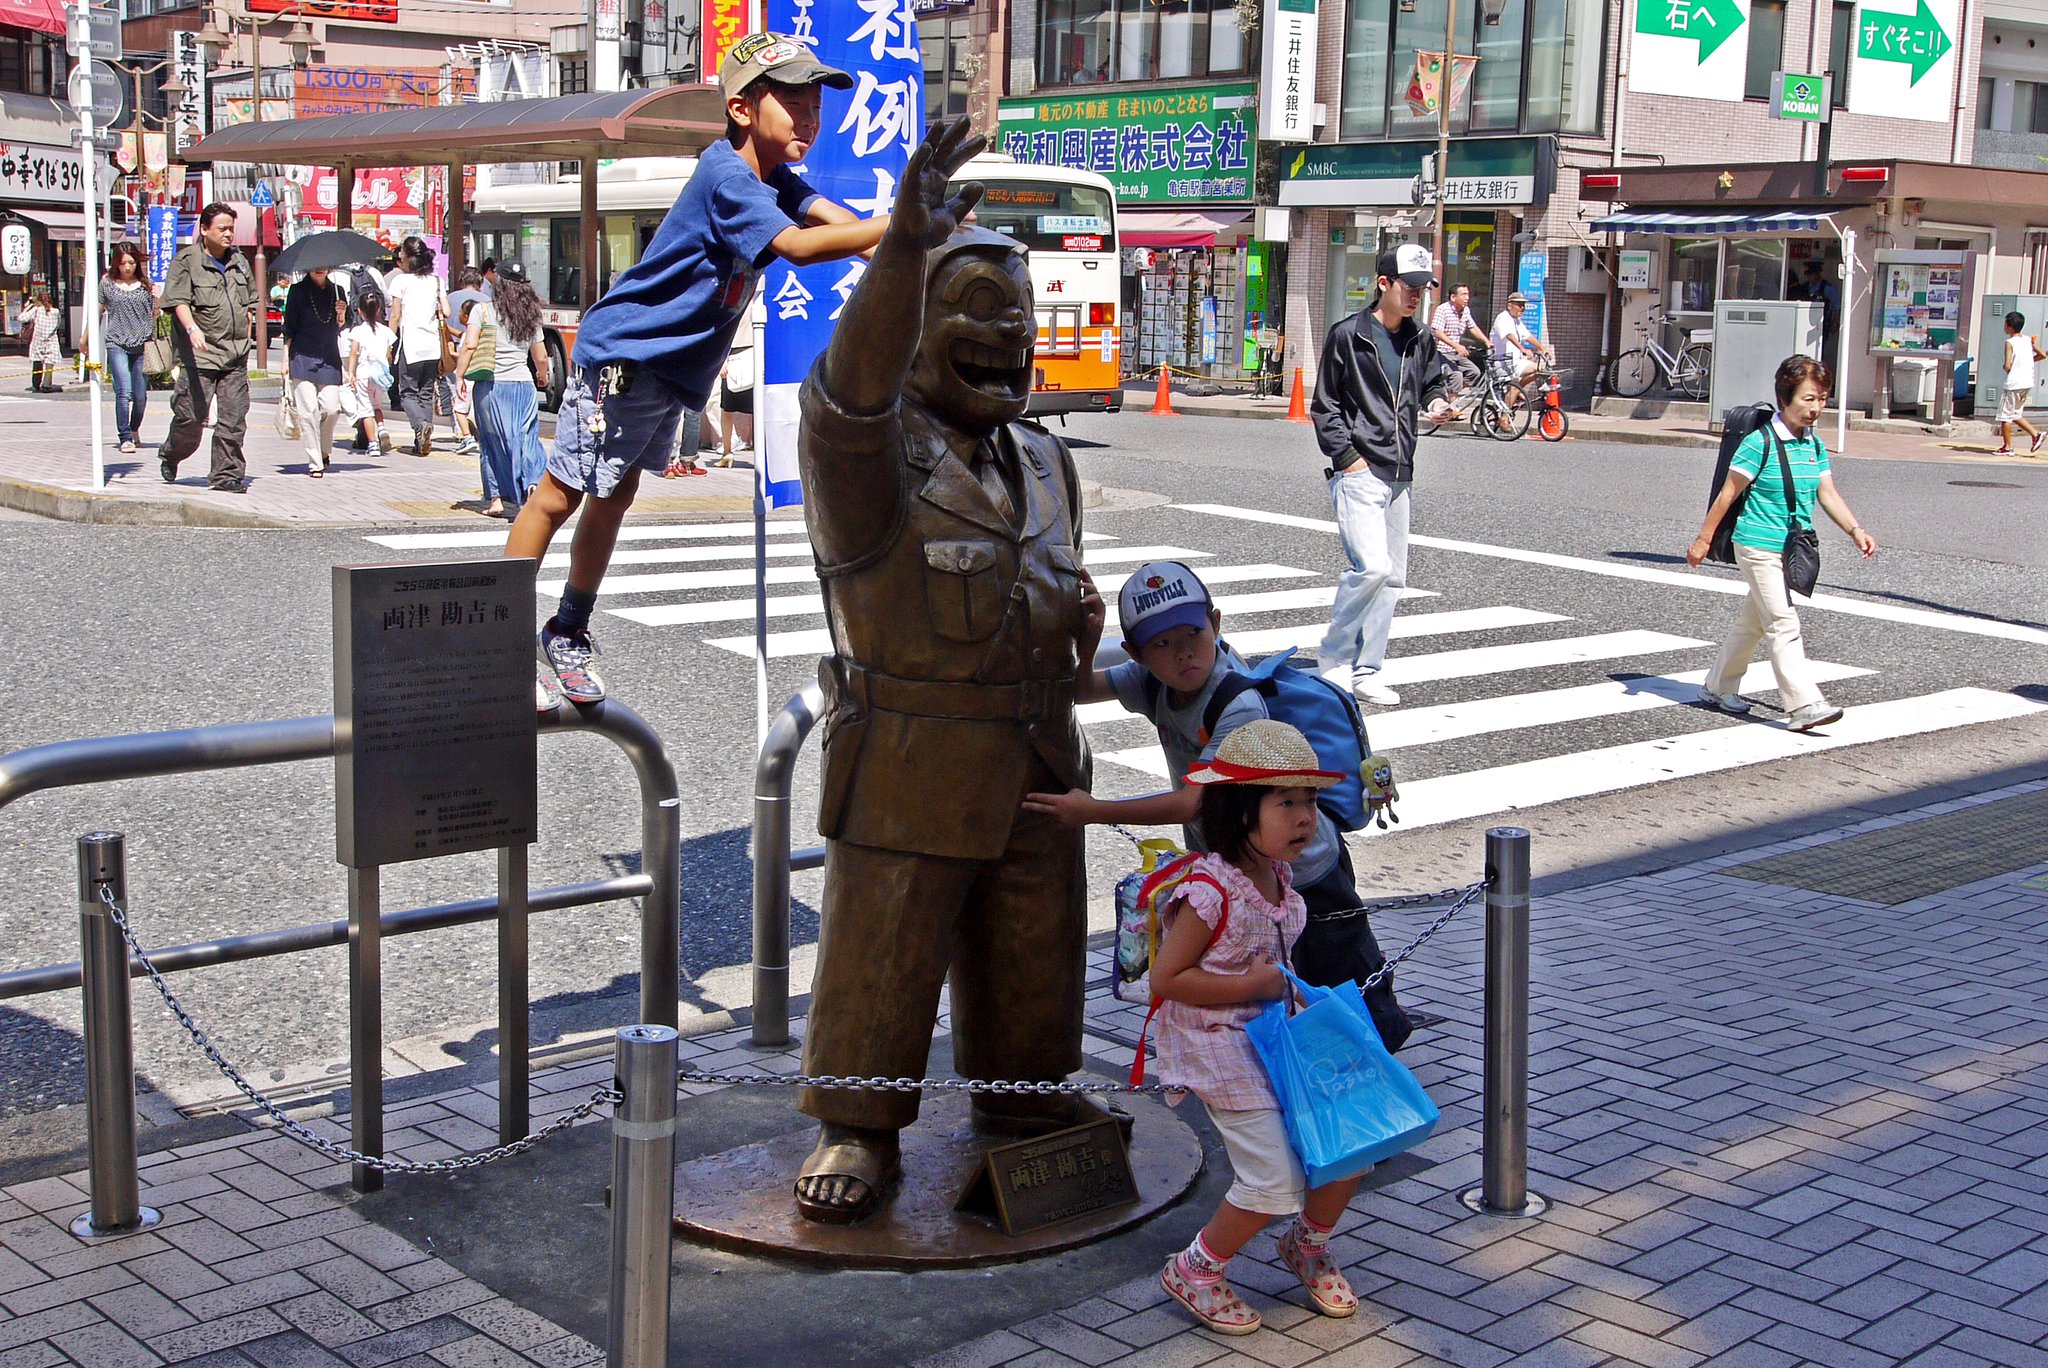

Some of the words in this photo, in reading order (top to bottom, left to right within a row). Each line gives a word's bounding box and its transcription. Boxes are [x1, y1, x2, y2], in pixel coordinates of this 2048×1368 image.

[645, 0, 664, 22] 傘
[1665, 0, 1717, 31] 右へ
[1863, 20, 1942, 58] すぐそこ!!
[1284, 19, 1302, 129] 三井住友銀行
[1039, 99, 1109, 122] 地元の不動産
[1117, 95, 1209, 118] 住まいのことなら
[1783, 100, 1818, 115] KOBAN
[1002, 119, 1248, 173] 協和興産株式会社
[2, 146, 99, 193] 中華そば39
[1306, 161, 1338, 176] SMBC
[1168, 178, 1247, 197] 亀有駅前営業所
[1443, 180, 1519, 200] 井住友銀行
[772, 269, 814, 321] 会
[1132, 578, 1188, 615] LOUISVILLE
[383, 603, 431, 631] 両津
[441, 600, 487, 627] 勘吉
[1307, 1054, 1390, 1097] Pastel
